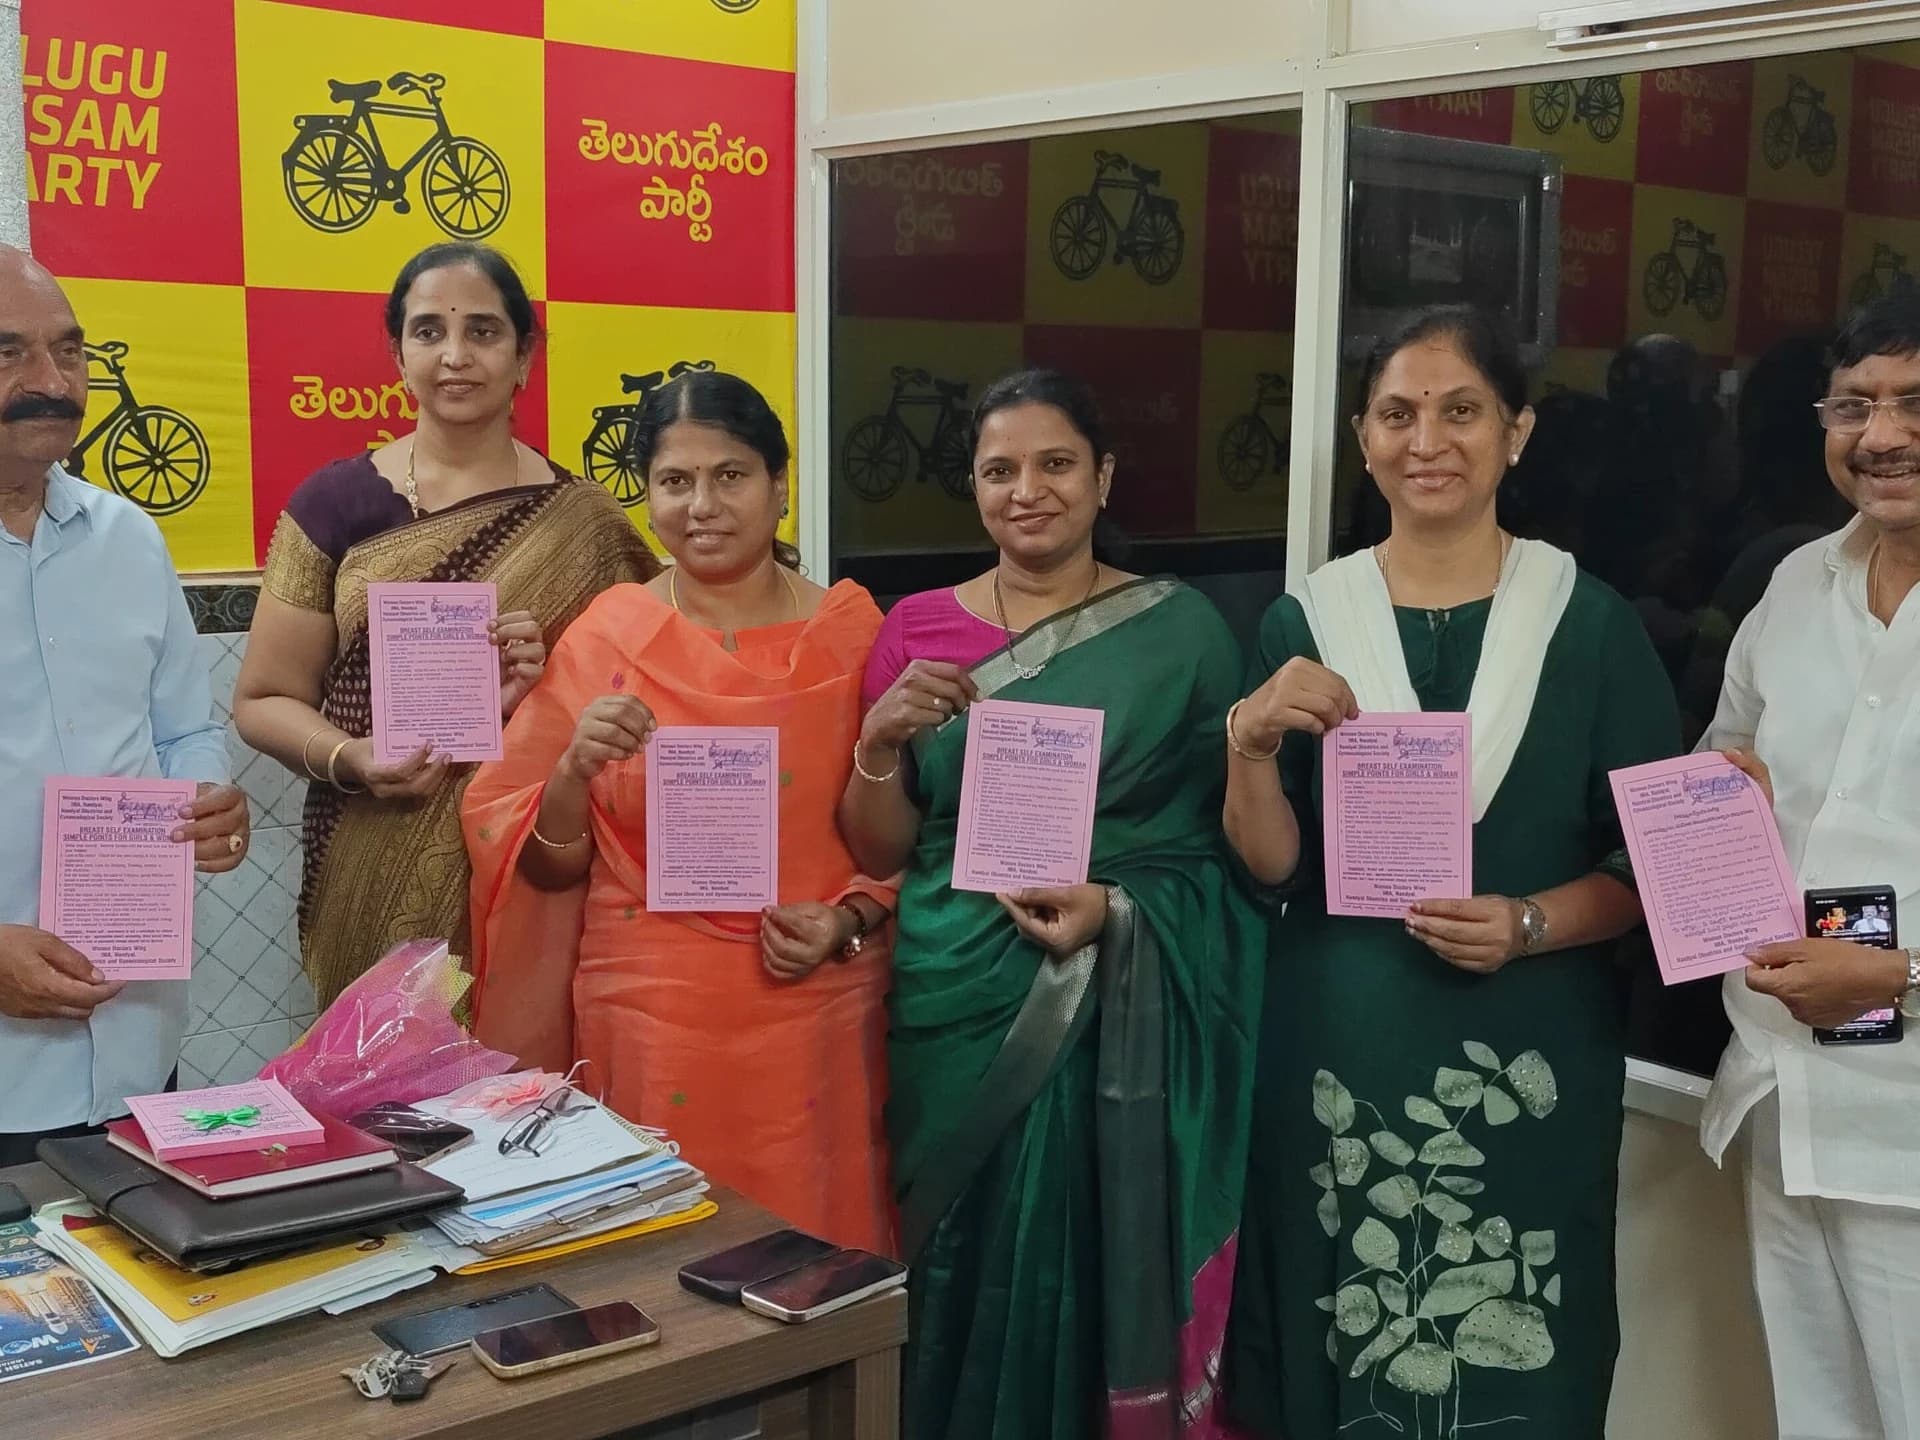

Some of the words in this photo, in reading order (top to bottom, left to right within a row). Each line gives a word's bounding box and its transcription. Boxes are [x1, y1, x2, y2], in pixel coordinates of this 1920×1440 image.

[20, 34, 167, 100] LUGU
[23, 93, 160, 155] SAM
[579, 118, 768, 176] తెలుగుదేశం
[640, 173, 713, 242] పార్టీ
